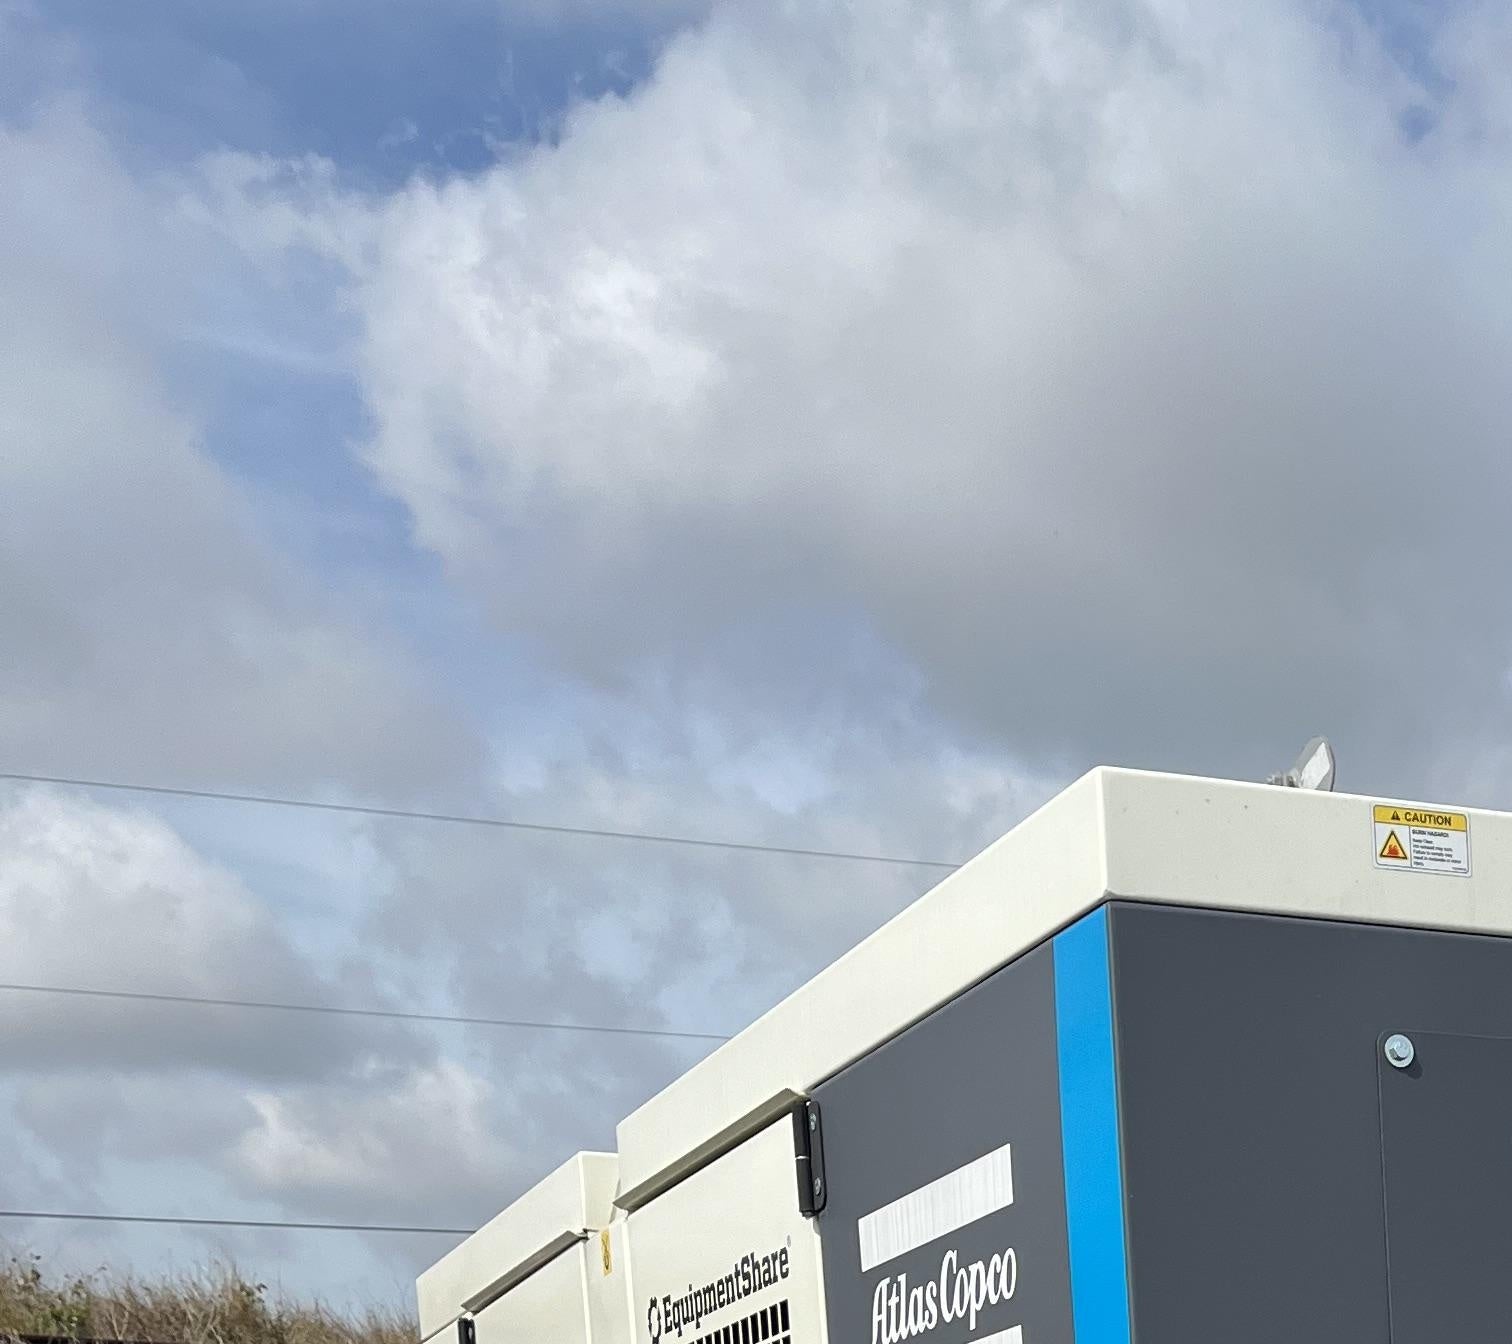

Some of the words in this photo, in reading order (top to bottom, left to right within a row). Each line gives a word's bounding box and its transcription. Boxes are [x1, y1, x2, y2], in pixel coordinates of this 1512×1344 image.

[1404, 811, 1452, 826] CAUTION
[662, 1246, 790, 1338] EquipmentShare
[940, 1247, 1017, 1331] Copco
